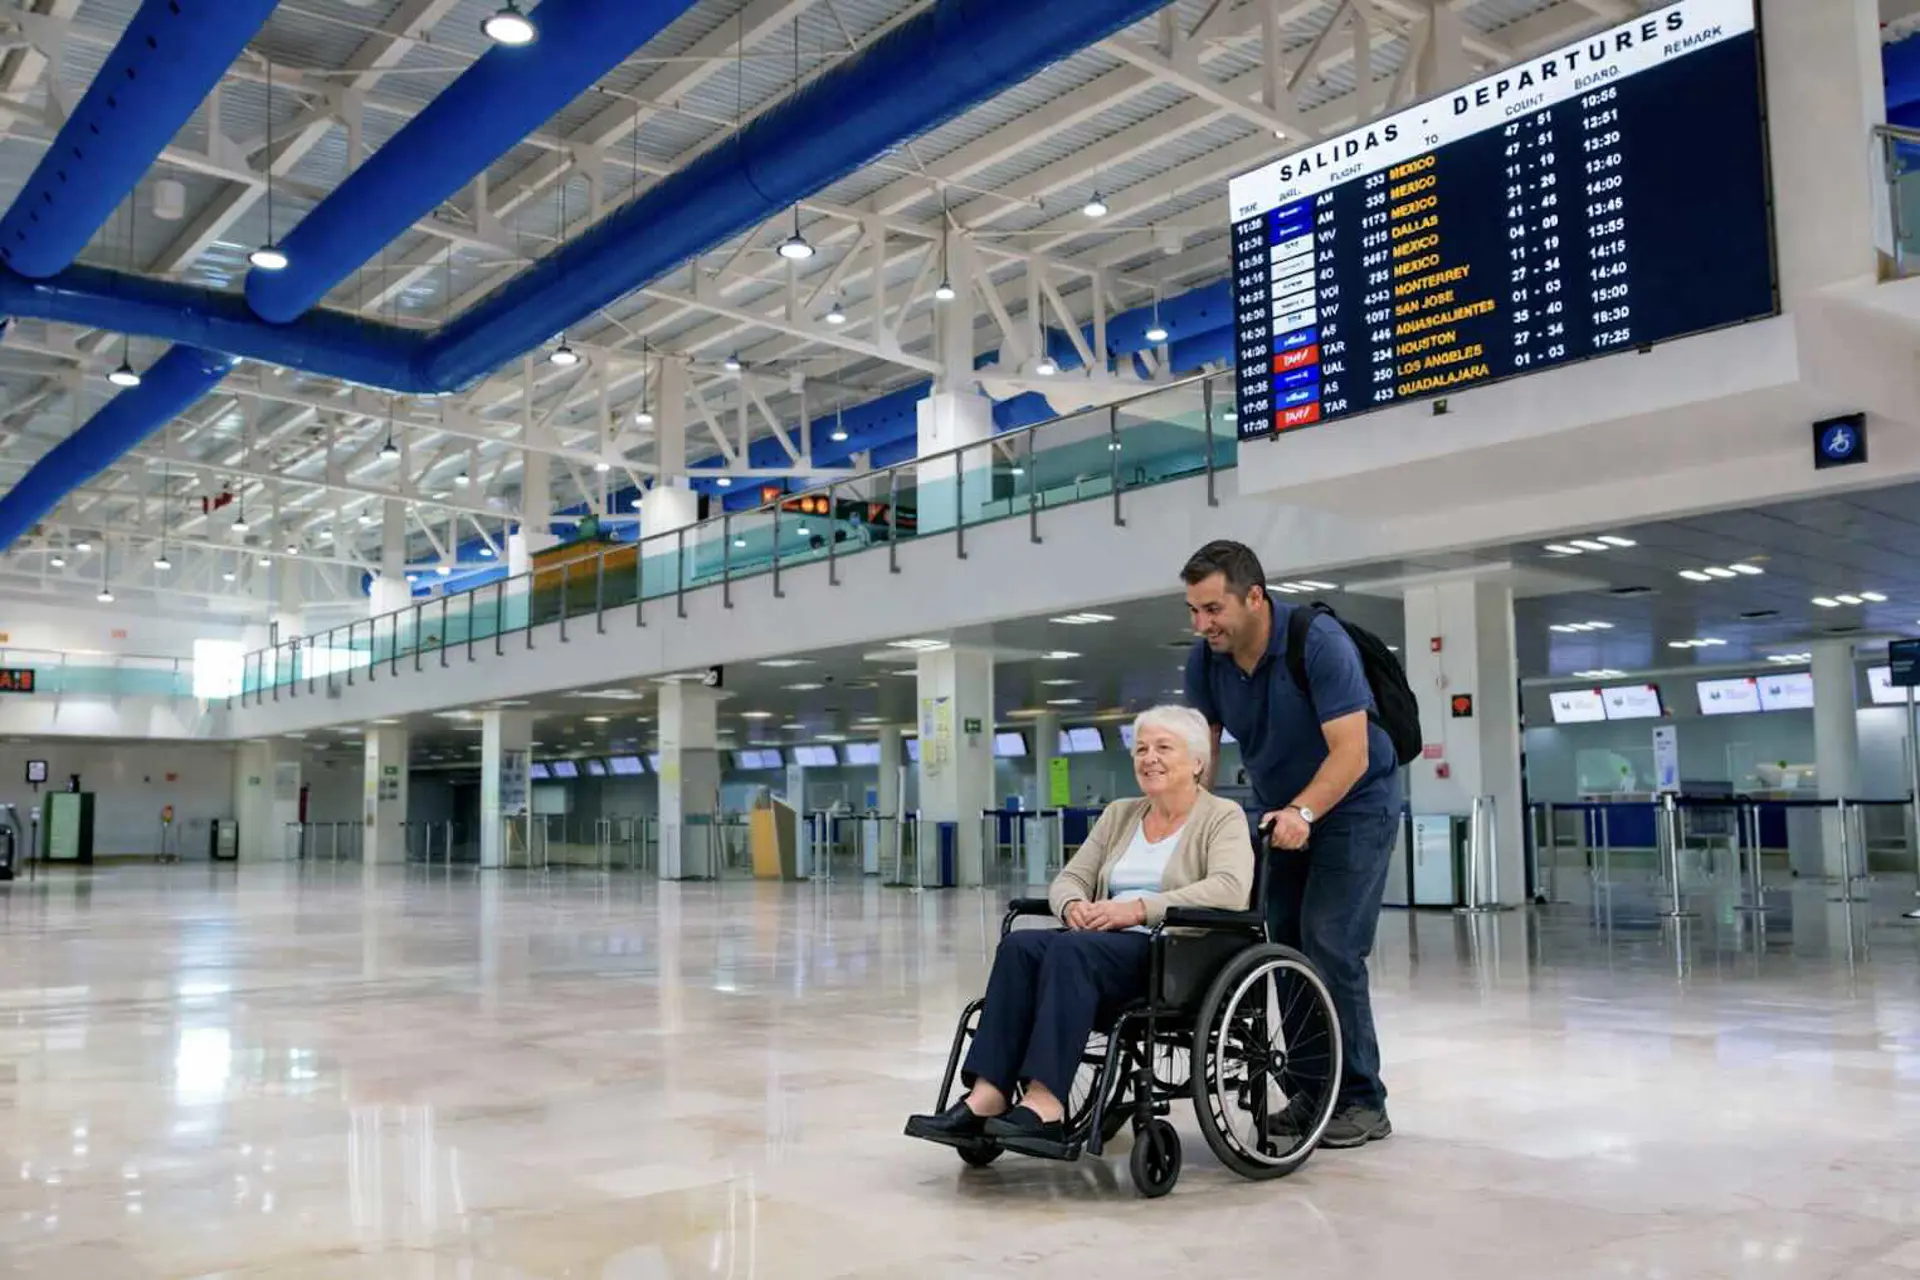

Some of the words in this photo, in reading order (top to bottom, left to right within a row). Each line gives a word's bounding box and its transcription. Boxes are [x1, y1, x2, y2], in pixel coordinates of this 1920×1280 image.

[1280, 124, 1398, 182] SALIDAS
[1453, 11, 1685, 115] DEPARTURES
[1425, 135, 1439, 145] TO
[1505, 94, 1544, 116] COUNT
[1663, 26, 1723, 57] REMARK
[1317, 192, 1334, 206] AM
[1389, 155, 1436, 180] MEXICO
[1504, 122, 1519, 136] 47
[1318, 210, 1334, 225] AM
[1390, 174, 1436, 200] MEXICO
[1505, 142, 1520, 156] 47
[1391, 195, 1438, 220] MEXICO
[1506, 164, 1520, 178] 11
[1392, 234, 1438, 258] MEXICO
[1508, 204, 1522, 218] 41
[1586, 174, 1622, 196] 14:00
[1392, 214, 1438, 239] DALLAS
[1320, 286, 1339, 298] VOI
[1394, 254, 1440, 278] MEXICO
[1510, 224, 1526, 239] 04
[1322, 324, 1336, 338] AS
[1395, 300, 1419, 316] SAN
[1422, 290, 1454, 309] JOSE
[1512, 266, 1526, 282] 27
[1544, 256, 1560, 272] 34
[1589, 240, 1626, 259] 14:15
[1394, 264, 1470, 296] MONTERREY
[1510, 246, 1525, 260] 11
[1322, 342, 1346, 356] TAR
[1512, 288, 1528, 302] 01
[1590, 262, 1627, 282] 14:40
[1322, 361, 1344, 375] UAL
[1396, 330, 1456, 356] HOUSTON
[1512, 309, 1529, 324] 35
[1546, 301, 1562, 314] 40
[1591, 284, 1628, 304] 15:00
[1324, 382, 1338, 395] AS
[1397, 360, 1421, 376] LOS
[1424, 344, 1482, 368] ANGELES
[1514, 330, 1530, 346] 27
[1547, 322, 1564, 337] 34
[1324, 400, 1347, 413] TAR
[1514, 352, 1530, 366] 01
[1592, 328, 1630, 348] 17:25
